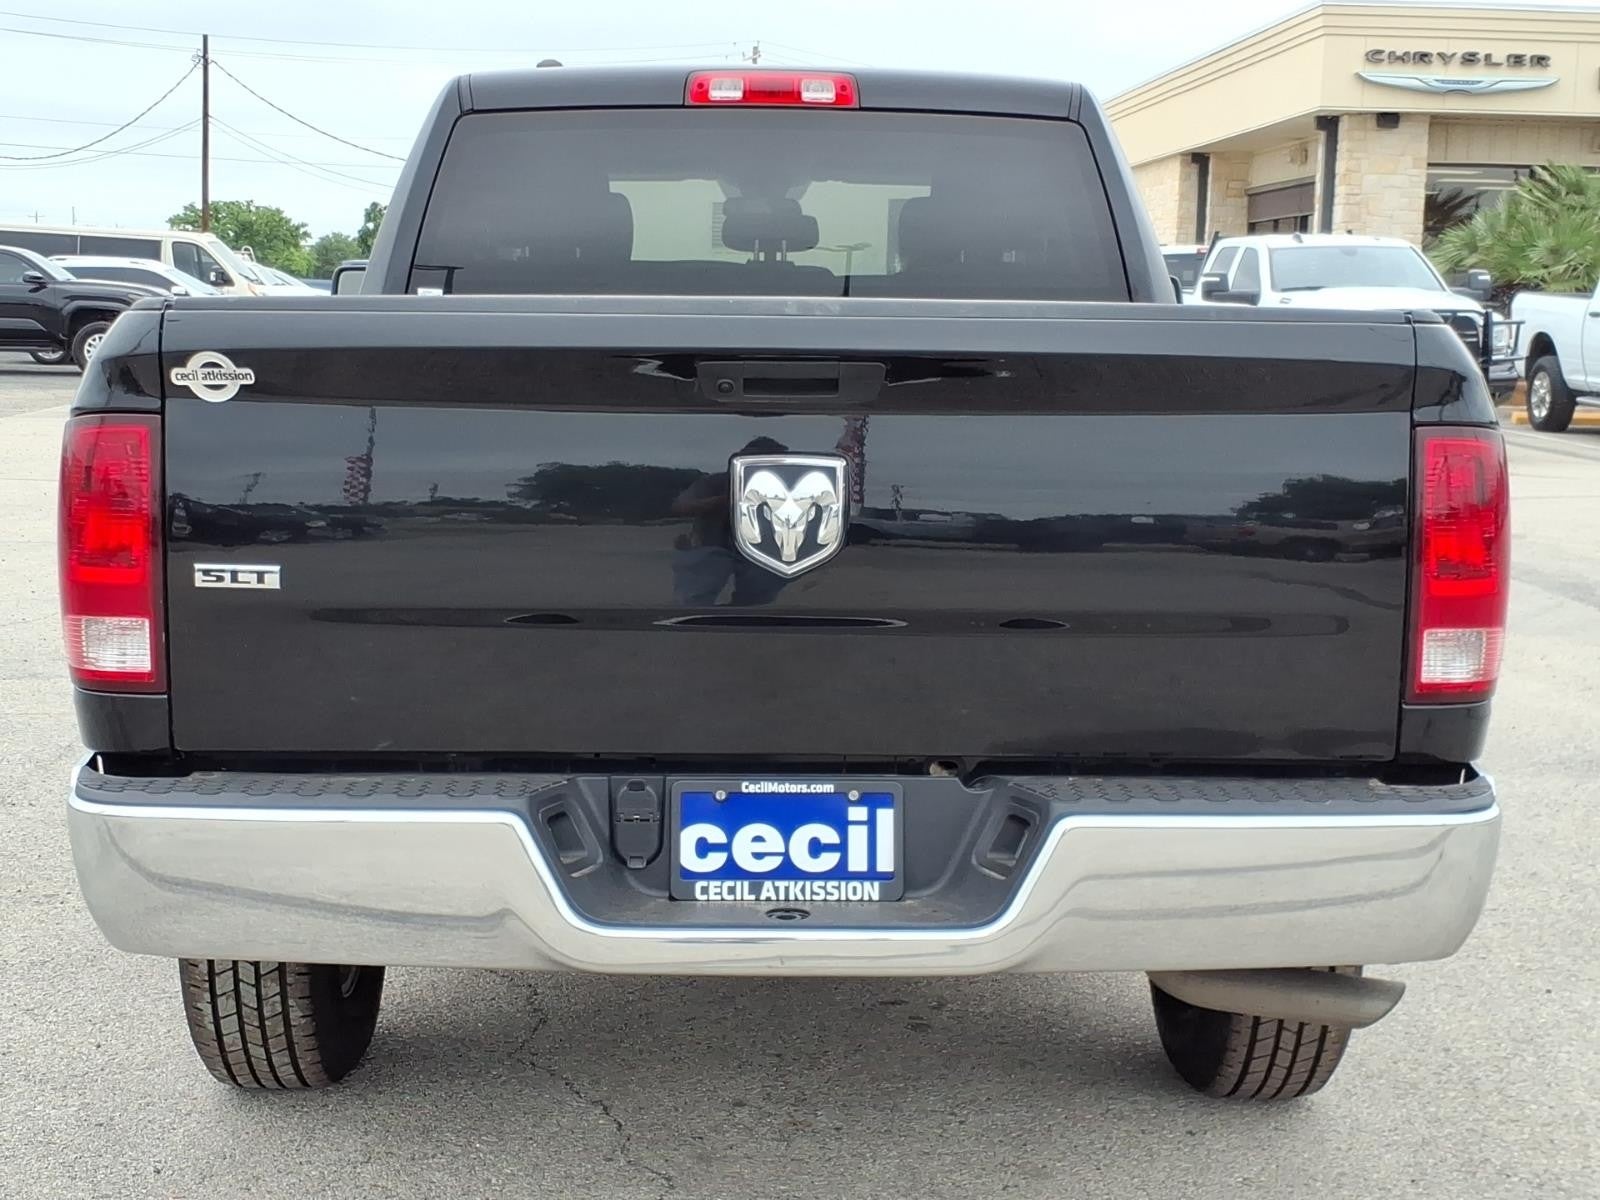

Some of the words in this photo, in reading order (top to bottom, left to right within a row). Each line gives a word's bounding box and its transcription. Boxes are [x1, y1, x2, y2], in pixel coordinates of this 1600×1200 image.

[1365, 49, 1551, 67] CHRYSLER
[175, 369, 198, 381] cecil
[201, 369, 253, 381] atkission
[196, 569, 279, 584] SLT
[741, 782, 835, 793] CecilMotors.com
[680, 806, 895, 872] cecil
[695, 881, 755, 901] CECIL
[761, 881, 879, 901] ATKISSION
